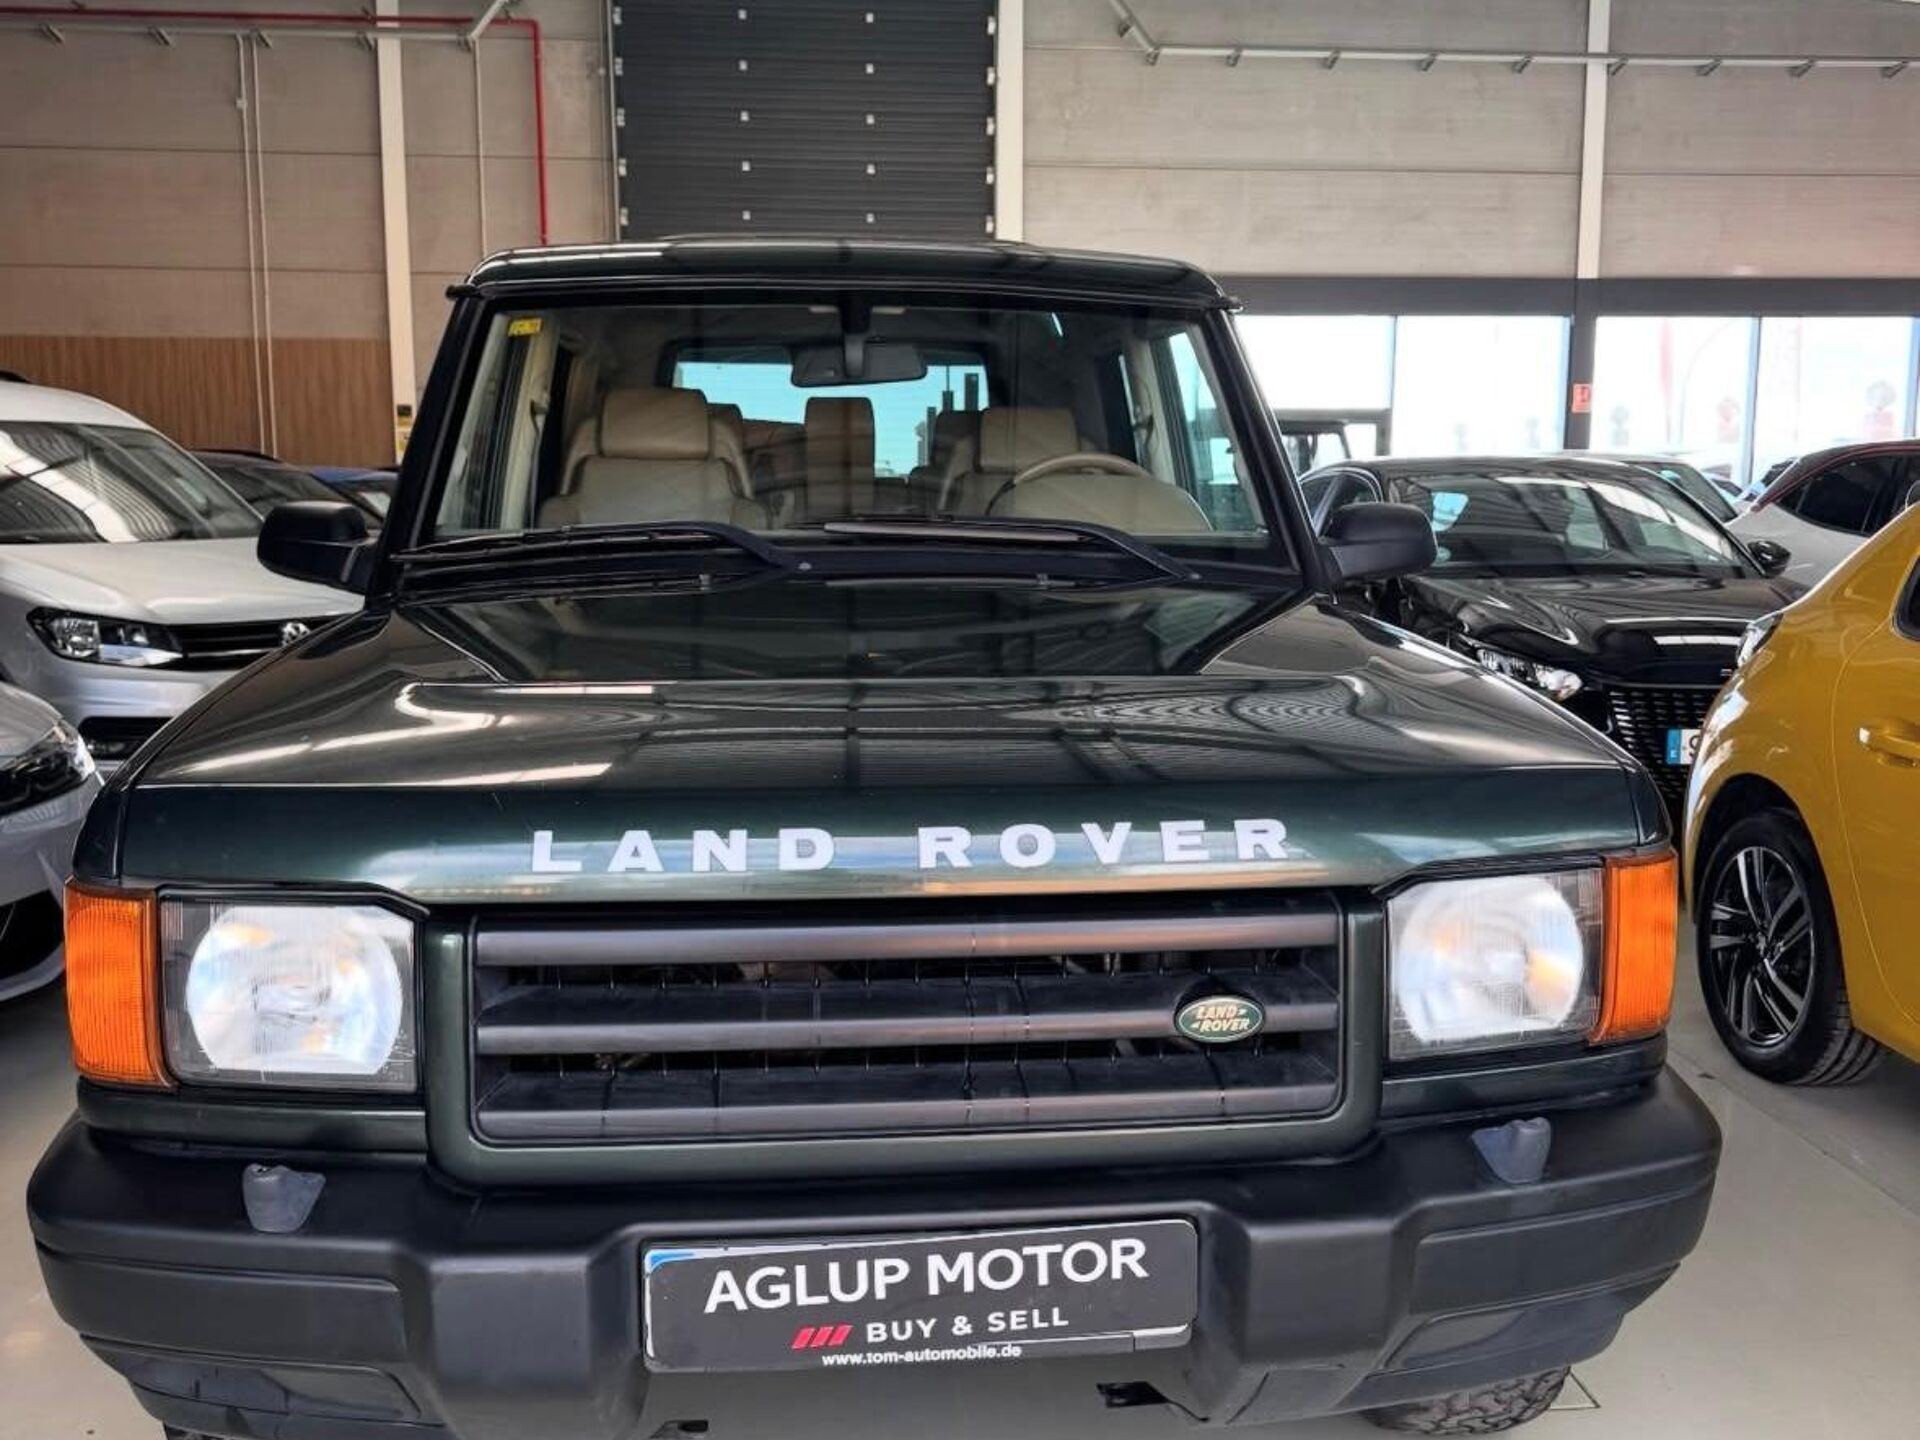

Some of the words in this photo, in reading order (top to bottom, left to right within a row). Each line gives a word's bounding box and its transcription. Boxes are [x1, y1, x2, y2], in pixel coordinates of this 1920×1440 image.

[531, 827, 837, 873] LAND
[917, 817, 1289, 869] ROVER
[1195, 1005, 1238, 1020] LAND
[1200, 1018, 1250, 1033] ROVER
[703, 1256, 910, 1314] AGLUP
[926, 1237, 1150, 1296] MOTOR
[865, 1317, 938, 1344] BUY
[951, 1314, 974, 1337] &
[986, 1306, 1070, 1333] SELL
